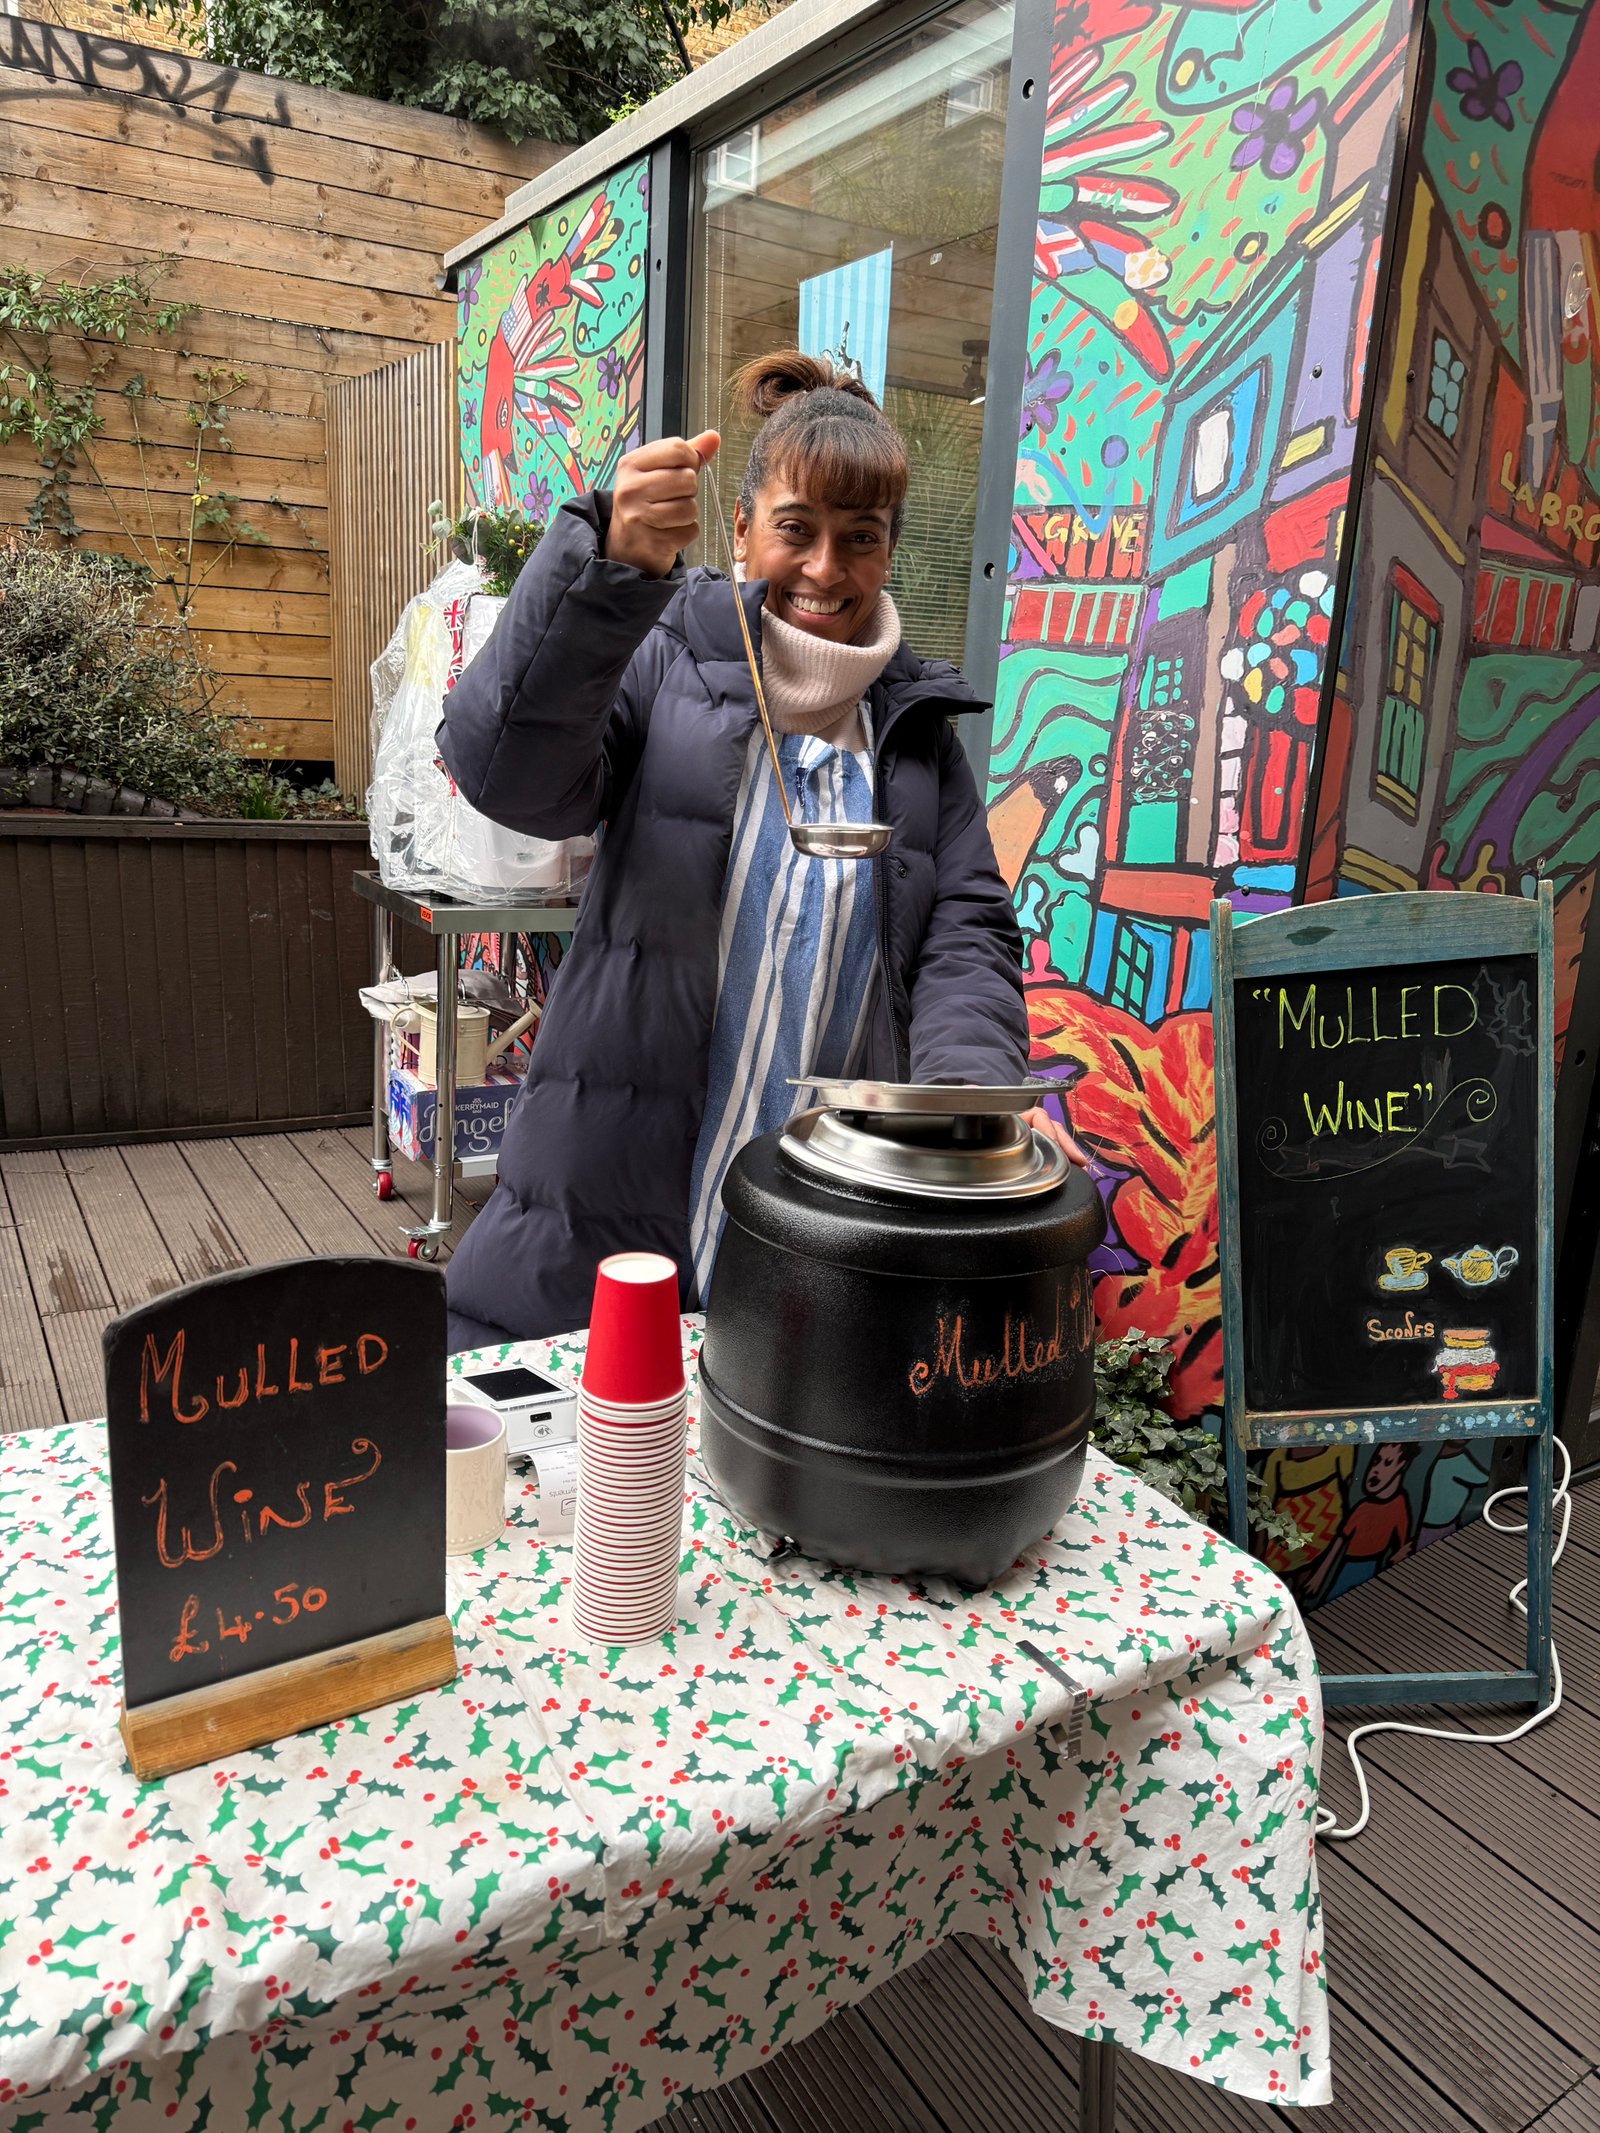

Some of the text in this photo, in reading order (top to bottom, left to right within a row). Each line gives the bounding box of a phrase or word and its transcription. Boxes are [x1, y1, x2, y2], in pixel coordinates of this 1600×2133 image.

[1045, 513, 1145, 553] GRVE
[455, 1101, 500, 1112] KERRYMAID
[138, 1329, 389, 1424] MULLED
[909, 1284, 1067, 1397] Mulled
[169, 1583, 328, 1662] £4.50
